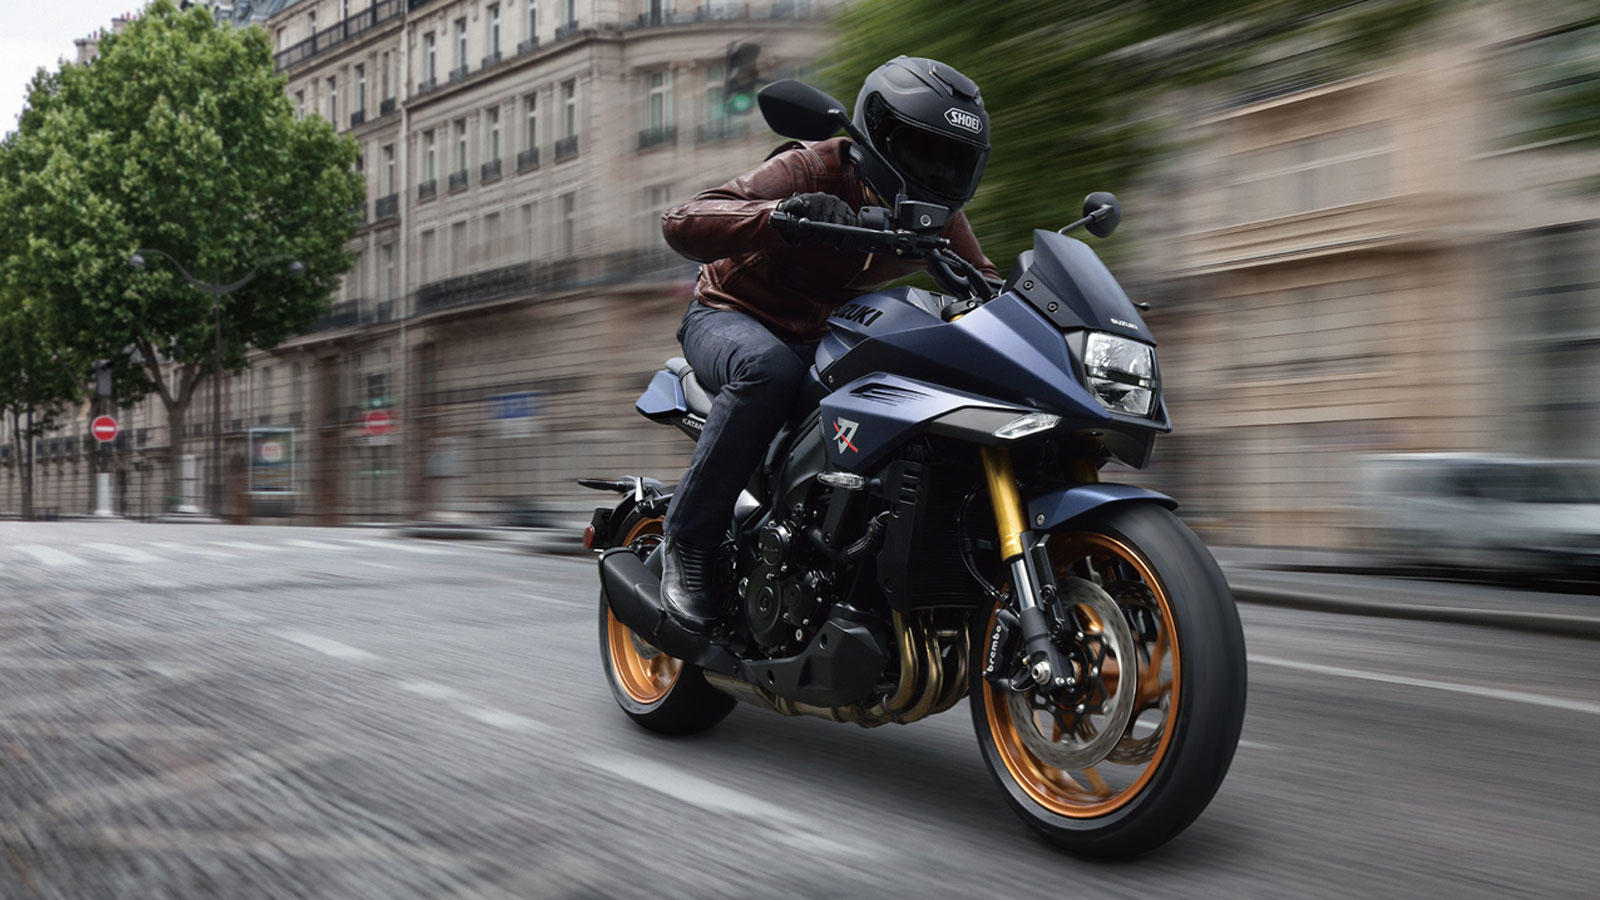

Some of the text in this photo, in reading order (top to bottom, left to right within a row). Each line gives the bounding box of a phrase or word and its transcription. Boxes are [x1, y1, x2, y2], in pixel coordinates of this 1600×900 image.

[951, 111, 979, 131] SHOEI
[835, 303, 883, 327] ZUKI
[682, 418, 705, 431] KATAN
[987, 625, 1002, 672] brembo
